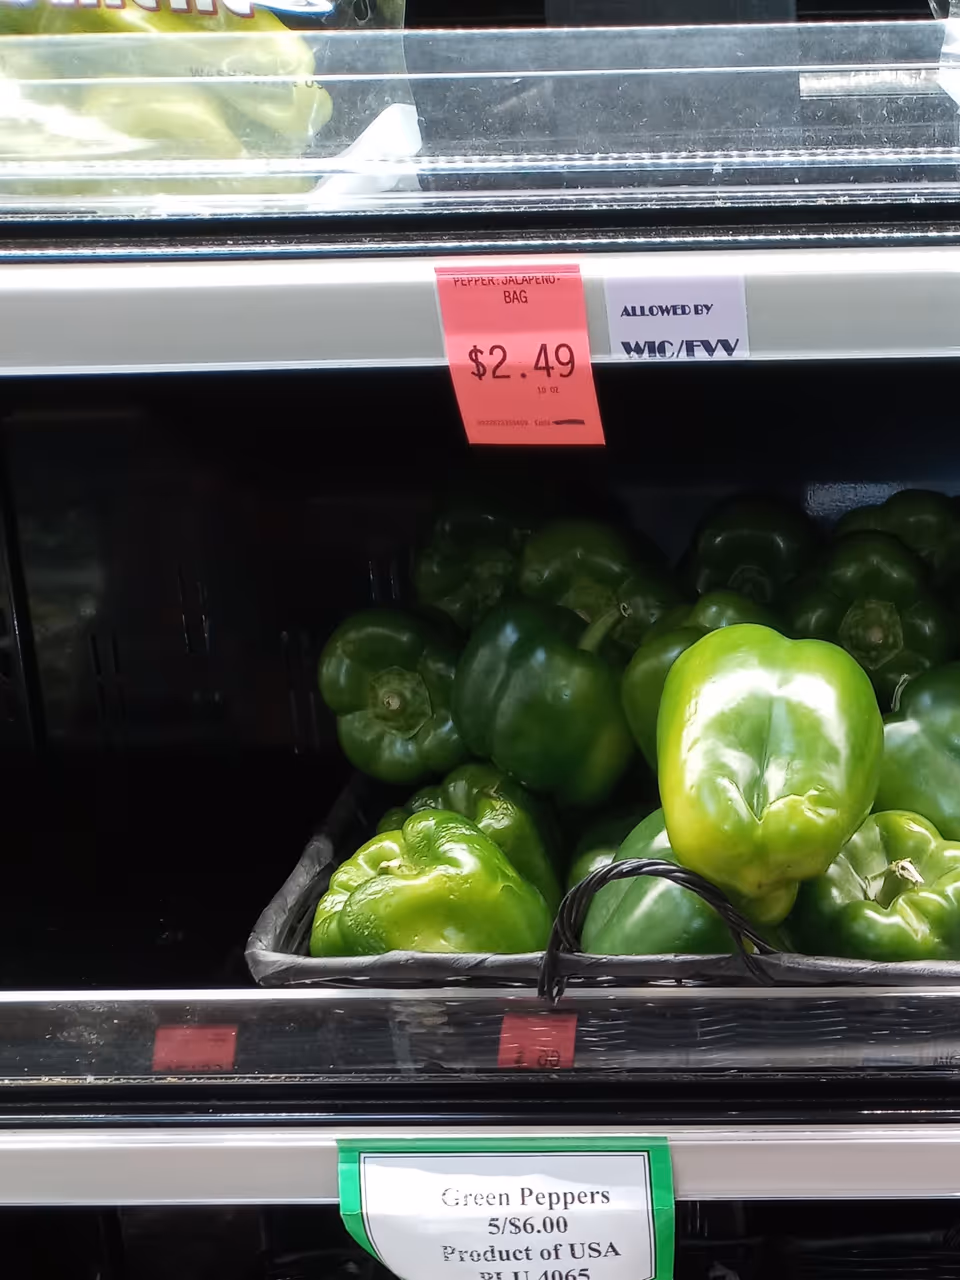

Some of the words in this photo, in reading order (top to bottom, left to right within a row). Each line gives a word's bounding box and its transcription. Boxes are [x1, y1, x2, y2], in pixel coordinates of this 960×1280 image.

[503, 289, 528, 304] BAG
[620, 304, 691, 317] ALLOWED
[693, 303, 713, 316] BY
[620, 338, 739, 358] WIC/FVV
[468, 342, 576, 381] $2.49
[441, 1187, 510, 1207] Green
[520, 1186, 611, 1210] Peppers
[488, 1216, 568, 1235] 5/$6.00
[441, 1245, 533, 1262] Product
[540, 1243, 563, 1260] of
[569, 1241, 622, 1259] USA
